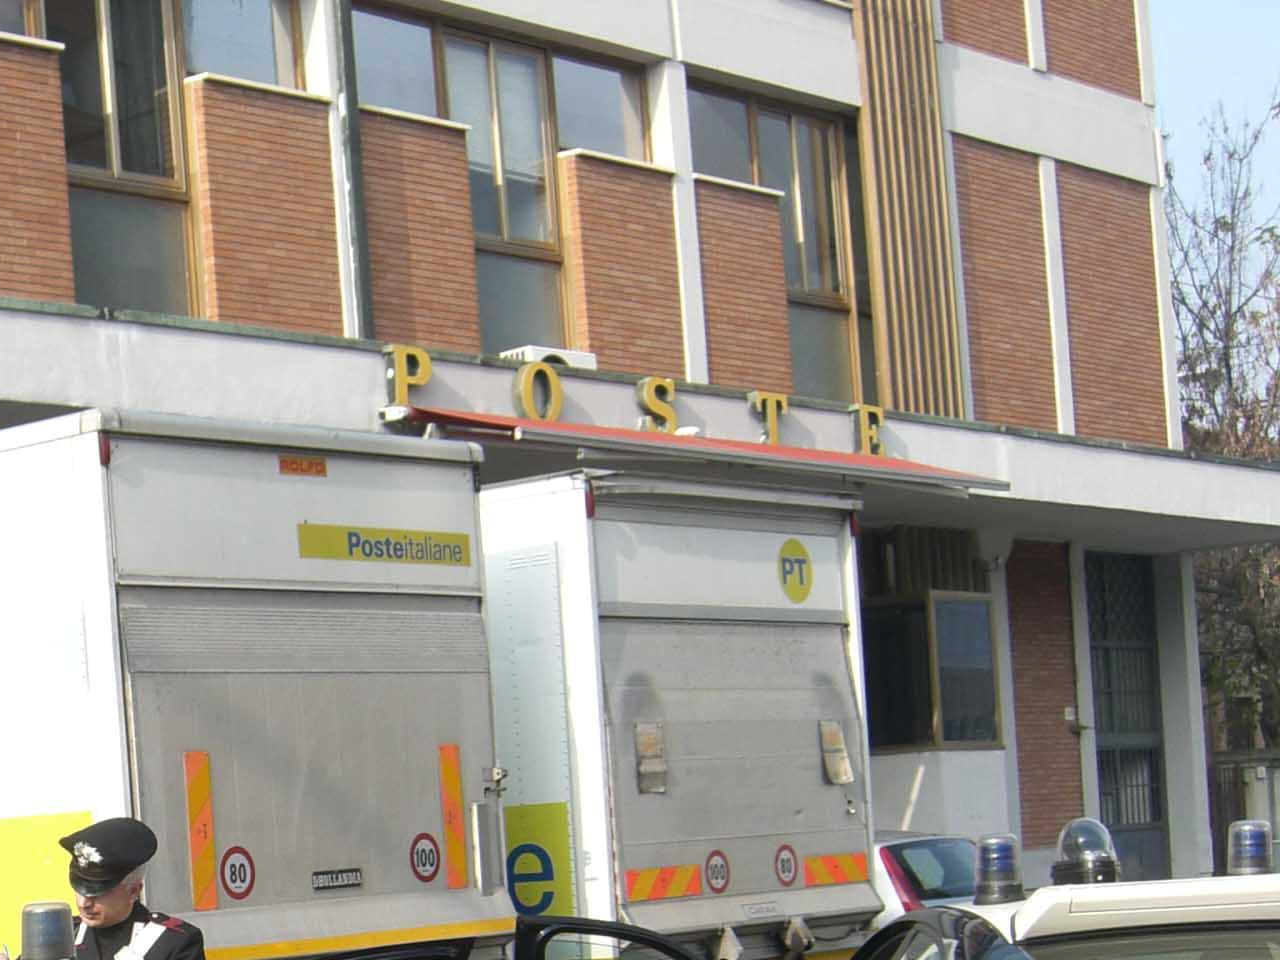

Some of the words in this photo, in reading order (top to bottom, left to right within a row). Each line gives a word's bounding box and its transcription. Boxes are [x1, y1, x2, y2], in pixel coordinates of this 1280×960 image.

[383, 344, 884, 456] POSTE
[347, 531, 463, 563] Posteitaliane
[782, 557, 807, 585] PT
[415, 847, 436, 868] 100
[228, 862, 248, 884] 80
